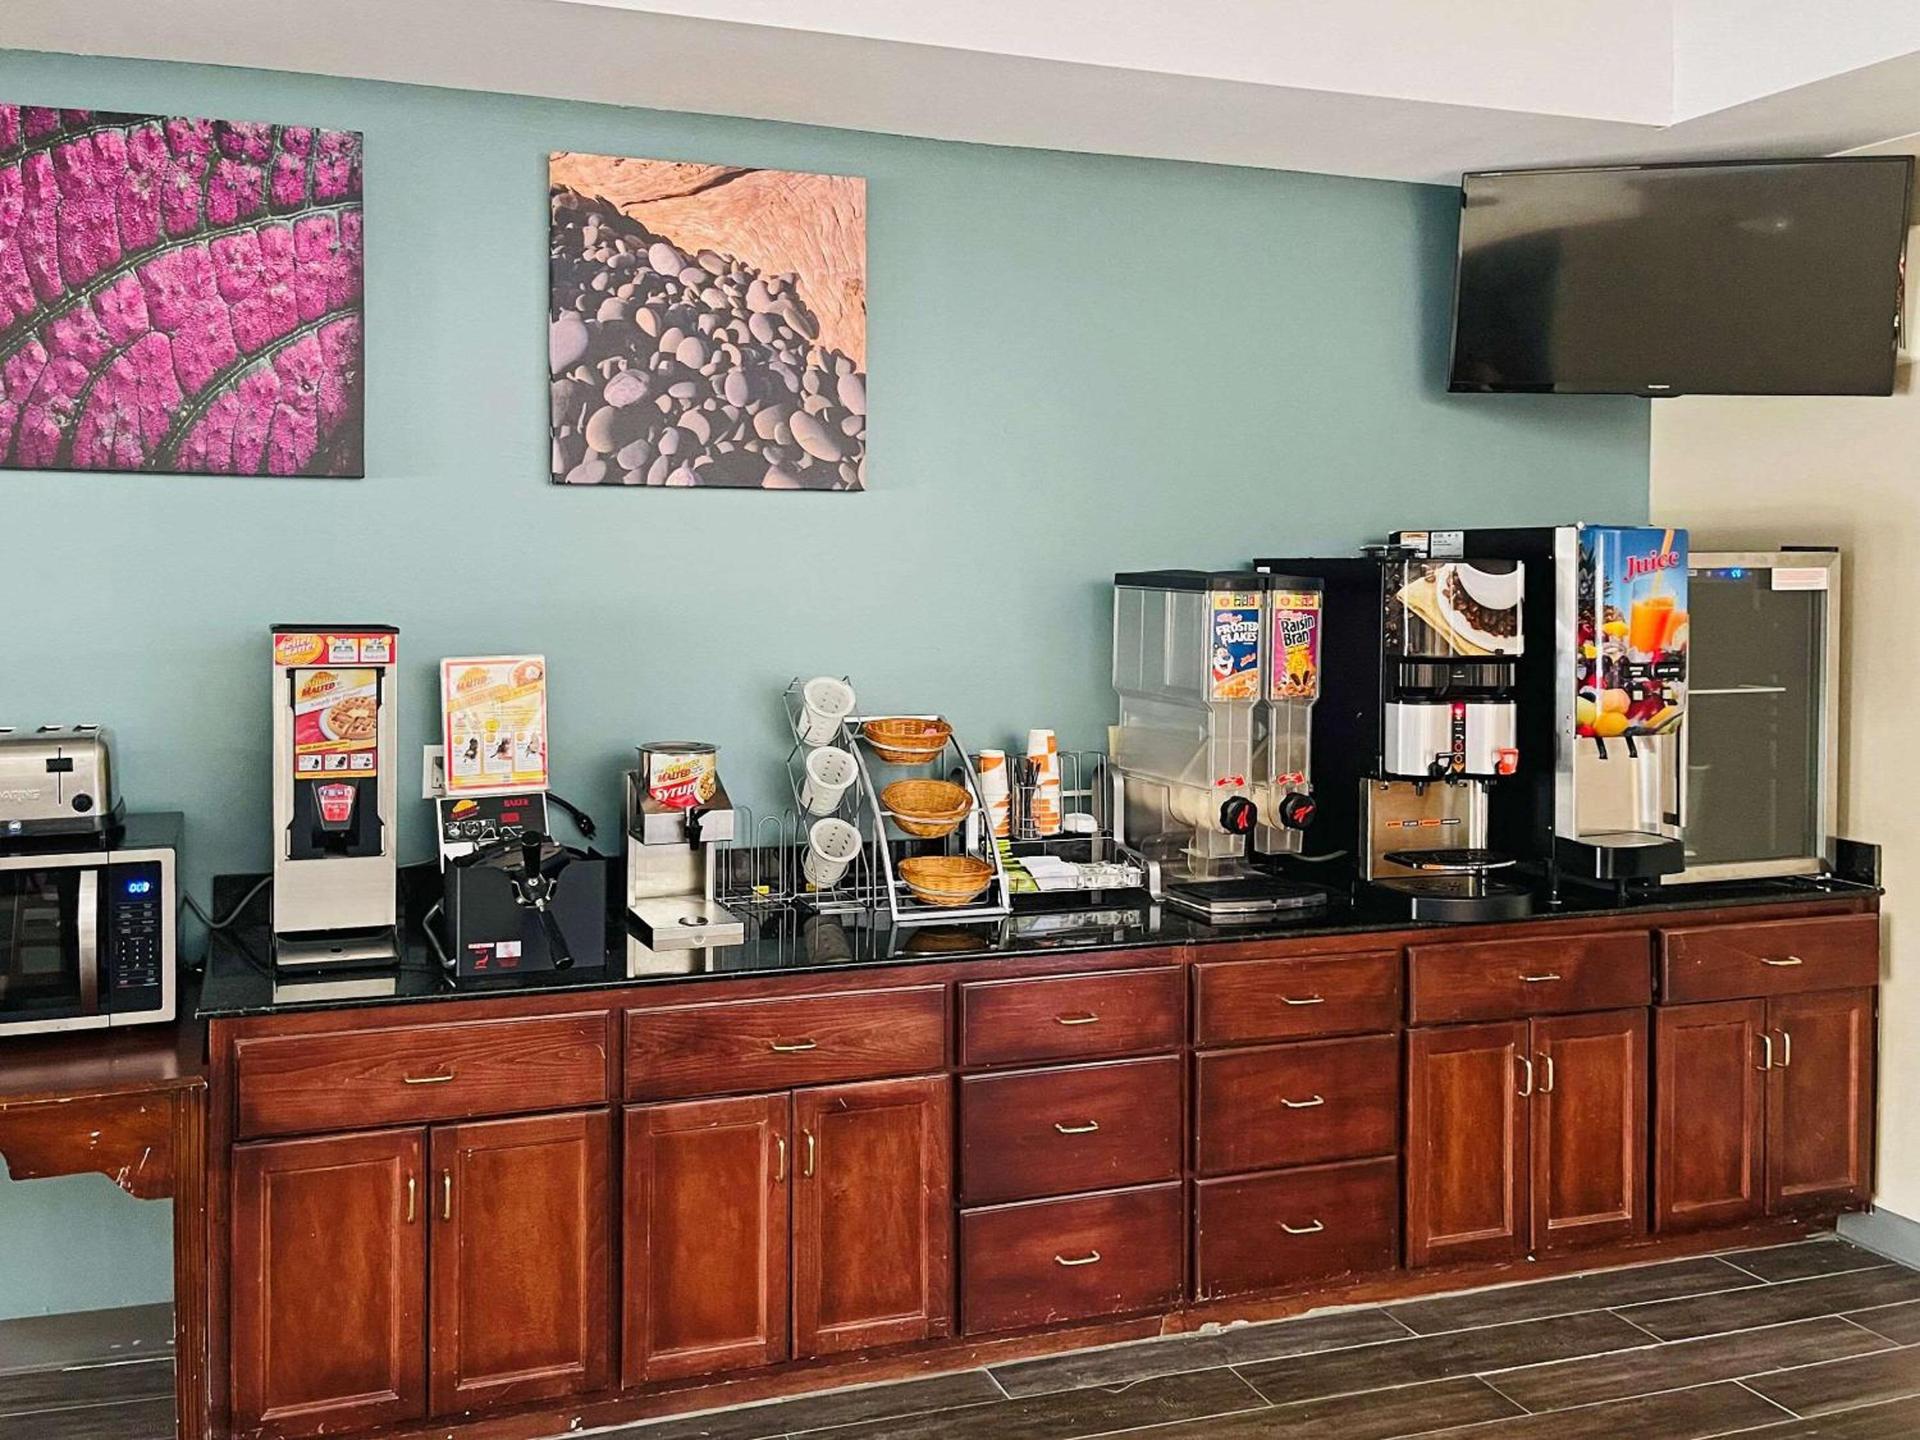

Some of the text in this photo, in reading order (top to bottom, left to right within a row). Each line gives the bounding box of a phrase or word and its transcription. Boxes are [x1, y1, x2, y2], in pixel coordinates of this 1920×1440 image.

[1622, 550, 1680, 583] Juice
[1216, 622, 1259, 636] FROSTED
[1281, 615, 1313, 632] Raisin
[1221, 632, 1257, 646] FLAKES
[1284, 631, 1309, 646] Bran
[302, 682, 336, 697] MALTED
[657, 768, 691, 783] MALTED
[656, 782, 697, 801] Syrup
